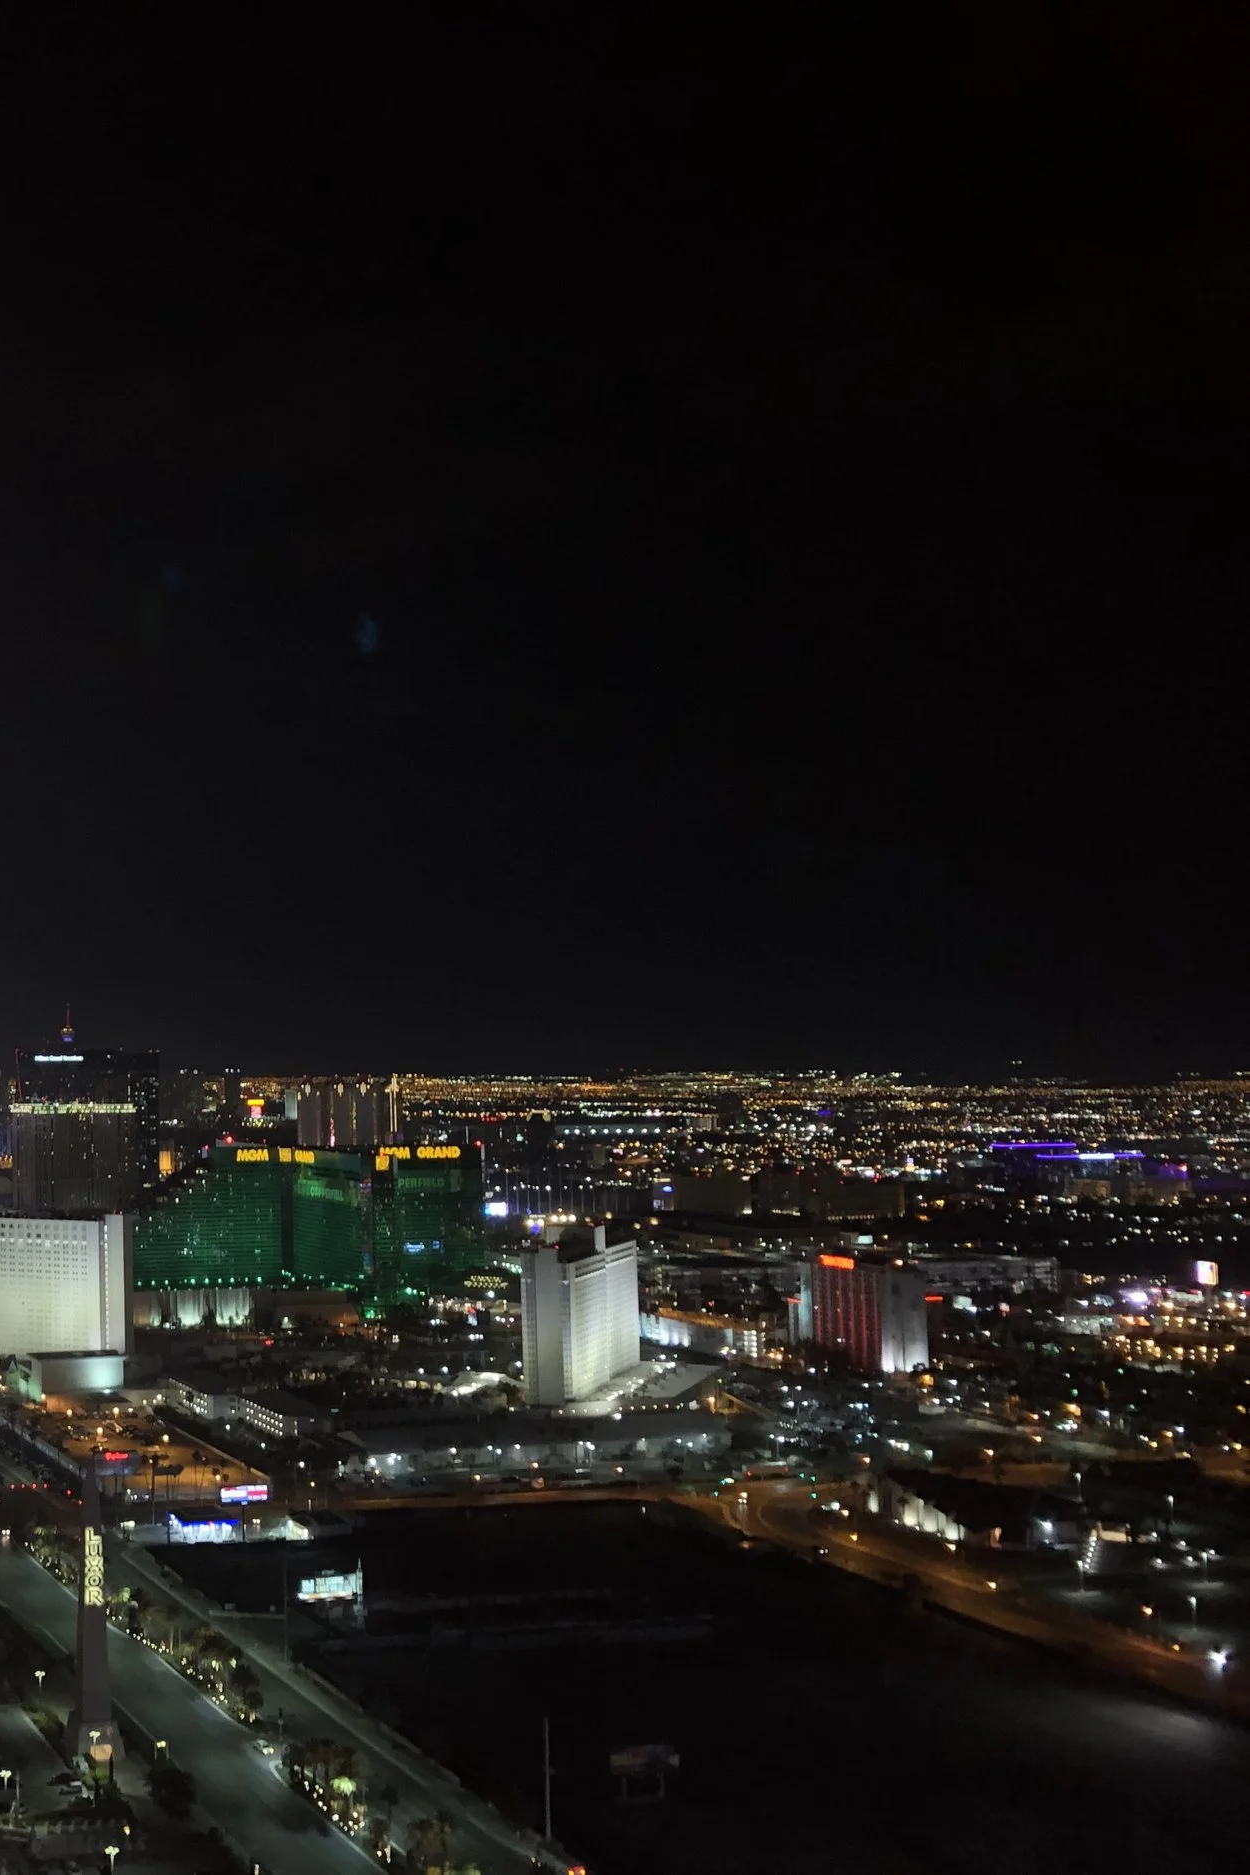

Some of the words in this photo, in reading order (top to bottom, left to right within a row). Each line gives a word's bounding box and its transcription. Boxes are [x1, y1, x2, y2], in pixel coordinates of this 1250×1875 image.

[236, 1148, 269, 1162] MGM
[379, 1146, 411, 1160] MGM
[416, 1145, 461, 1159] GRAND
[84, 1526, 105, 1606] LUXOR
